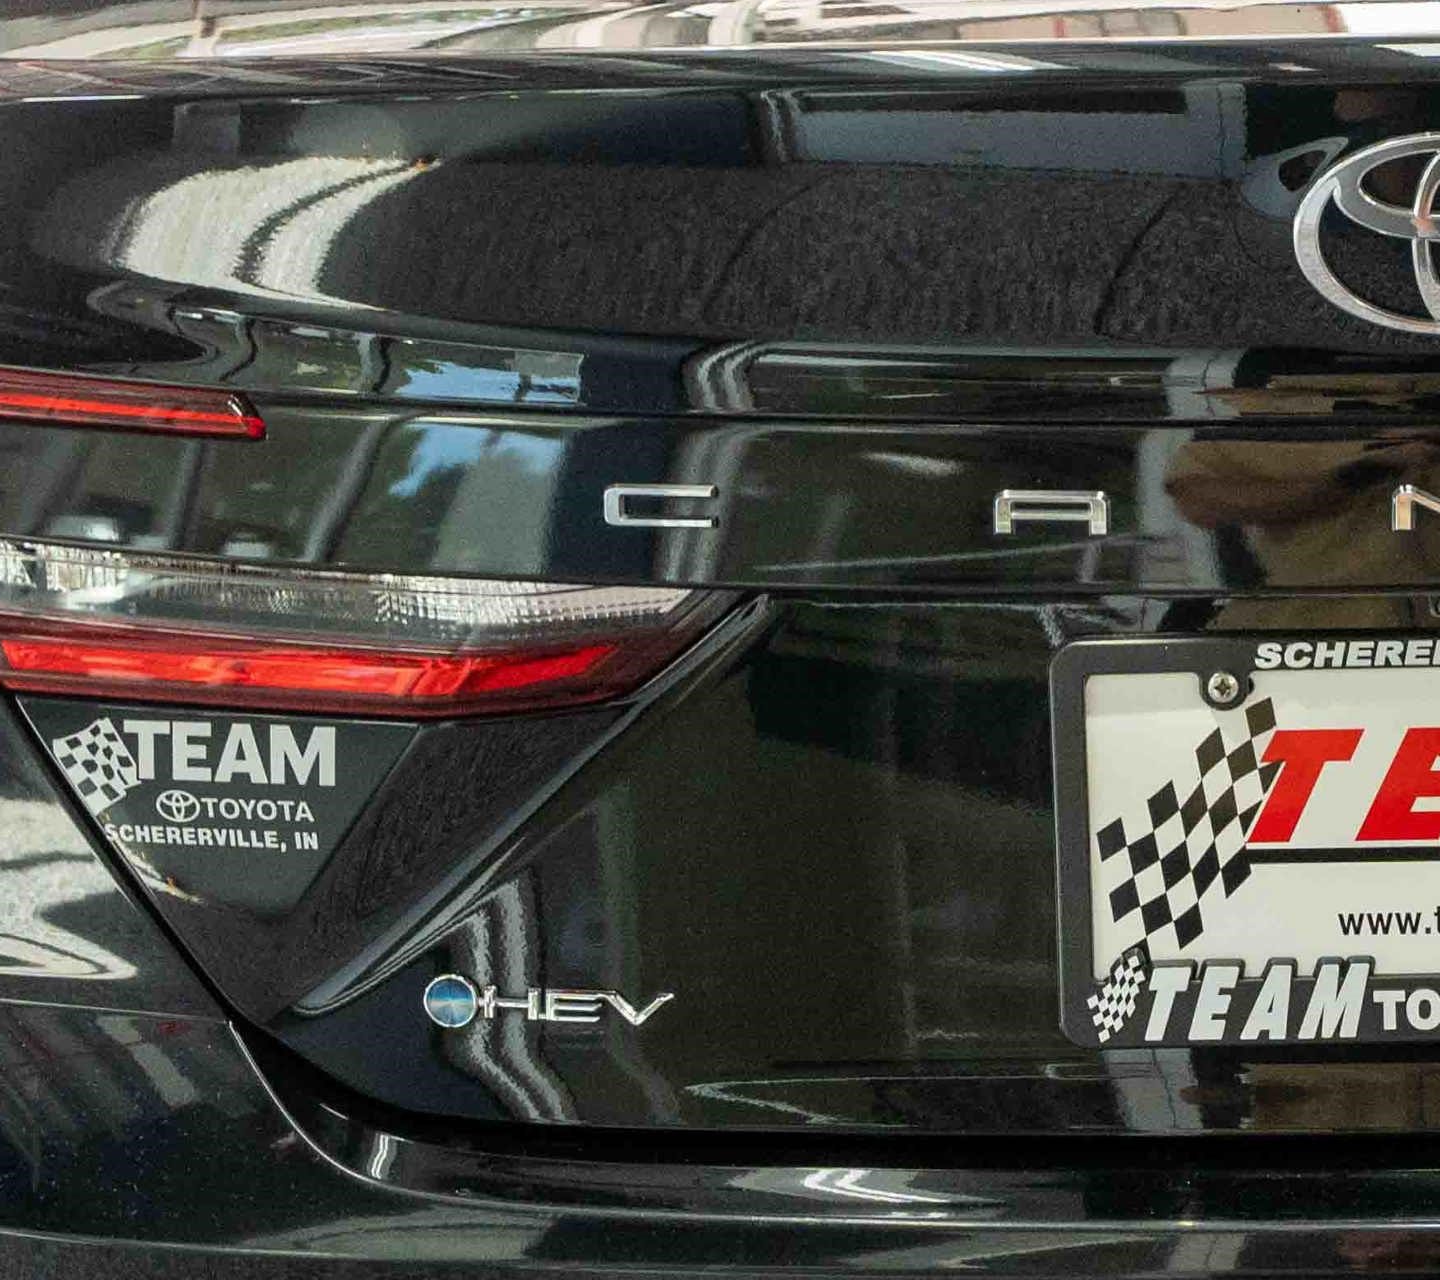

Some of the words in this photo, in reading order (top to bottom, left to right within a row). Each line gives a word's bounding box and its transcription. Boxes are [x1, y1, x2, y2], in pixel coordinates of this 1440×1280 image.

[123, 721, 336, 787] TEAM
[200, 797, 315, 823] TOYOTA
[104, 822, 287, 853] SCHERERVILLE,
[294, 830, 319, 851] IN
[480, 984, 675, 1026] HEV
[1143, 963, 1371, 1042] TEAM
